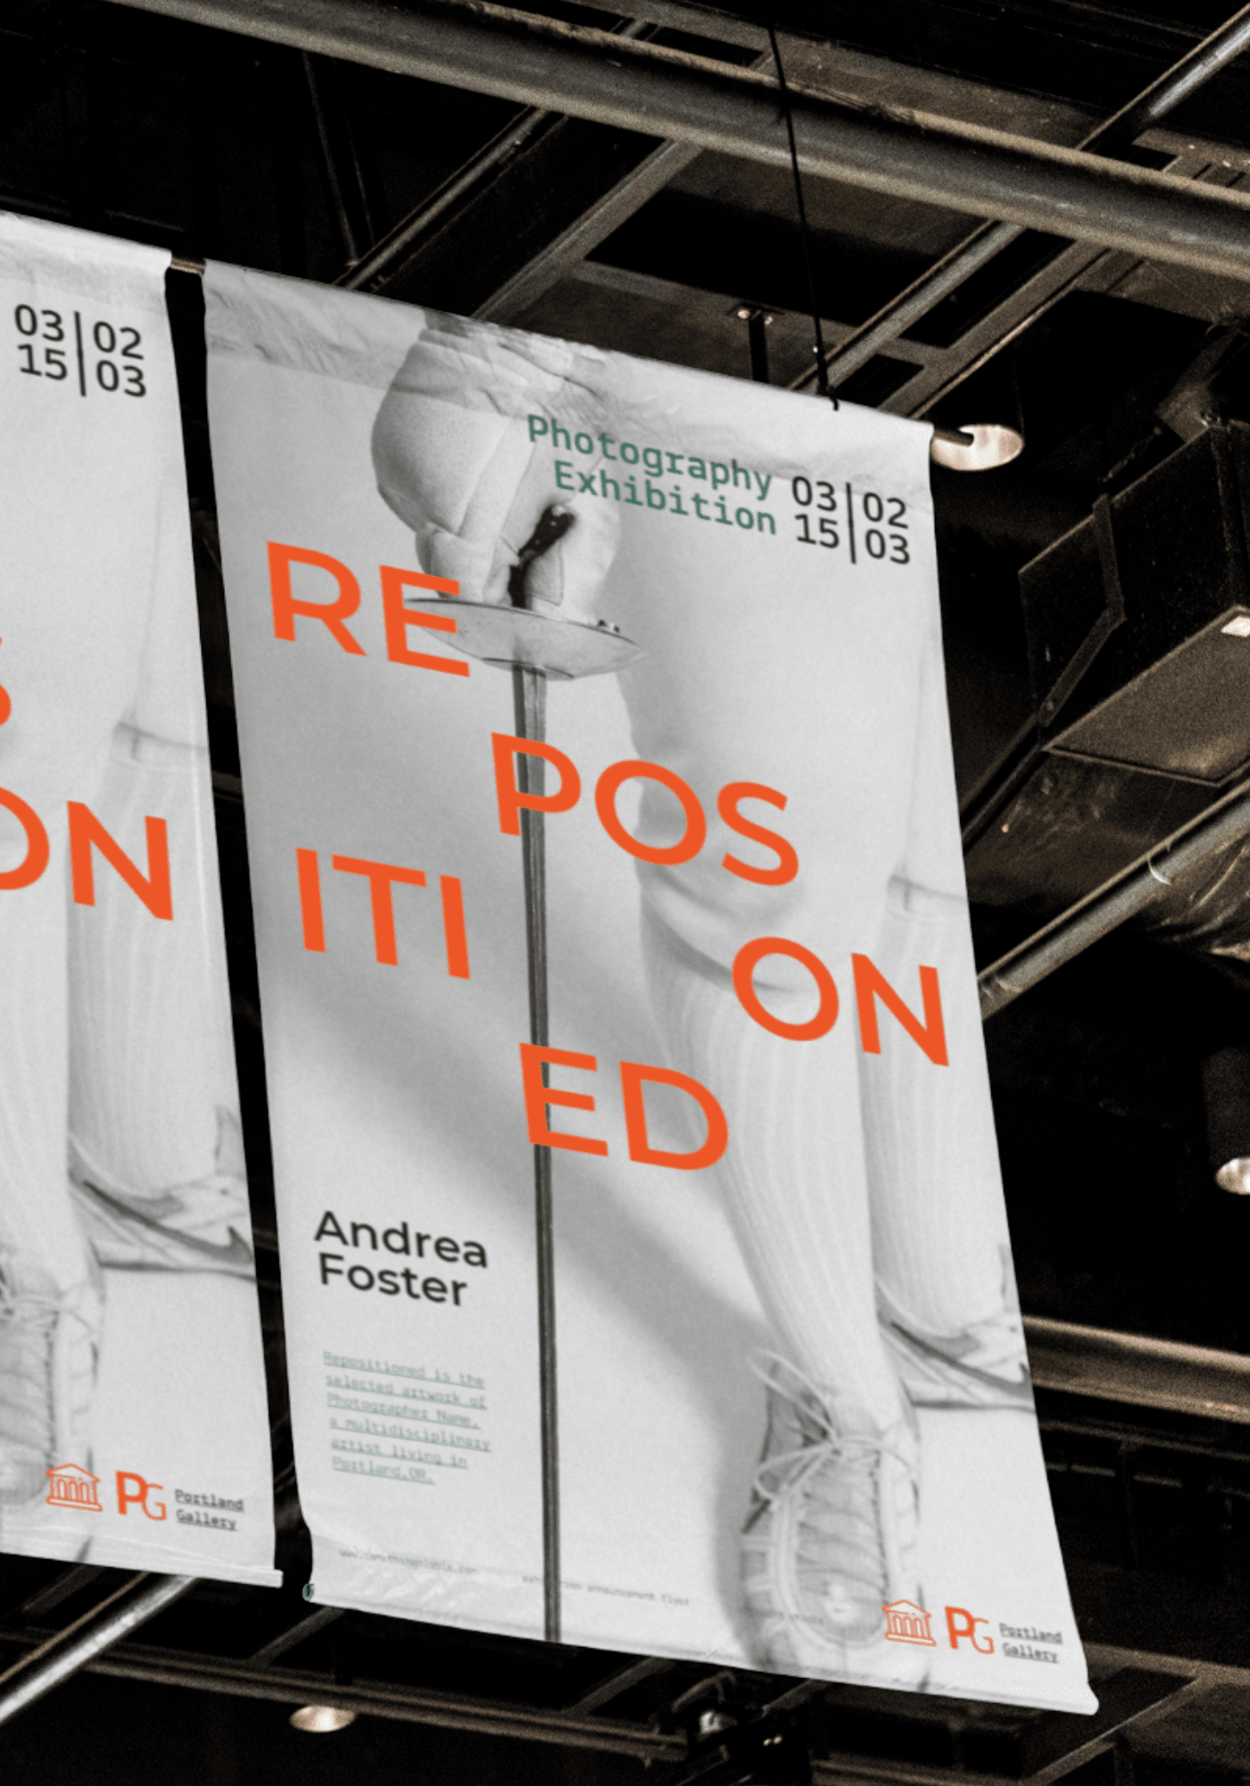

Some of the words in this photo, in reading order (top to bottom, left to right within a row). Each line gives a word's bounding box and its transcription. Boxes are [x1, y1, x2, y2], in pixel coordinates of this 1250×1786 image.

[14, 303, 66, 343] 03
[92, 320, 145, 361] 02
[17, 343, 69, 381] 15
[96, 359, 147, 398] 03
[527, 414, 773, 501] Photography
[554, 460, 777, 535] Exhibition
[791, 475, 838, 512] 03
[862, 491, 910, 530] 02
[794, 513, 841, 549] 15
[865, 528, 911, 565] 03
[266, 541, 471, 678] RE
[491, 732, 800, 887] POS
[295, 847, 471, 980] ITI
[731, 936, 950, 1067] ON
[519, 1042, 729, 1172] ED
[314, 1210, 488, 1269] Andrea
[318, 1252, 468, 1307] Foster
[323, 1350, 425, 1380] Repositioned
[434, 1369, 450, 1384] is
[459, 1373, 486, 1390] the
[326, 1374, 394, 1395] selected
[401, 1387, 460, 1406] artwork
[469, 1396, 487, 1411] of
[327, 1391, 428, 1421] Photographer
[331, 1437, 381, 1456] artist
[392, 1443, 442, 1466] living
[451, 1455, 468, 1470] in
[345, 1418, 491, 1453] multidisciplinary
[174, 1488, 245, 1513] Portland
[175, 1508, 237, 1532] Gallery
[999, 1622, 1063, 1645] Portland
[1002, 1642, 1059, 1664] Gallery
